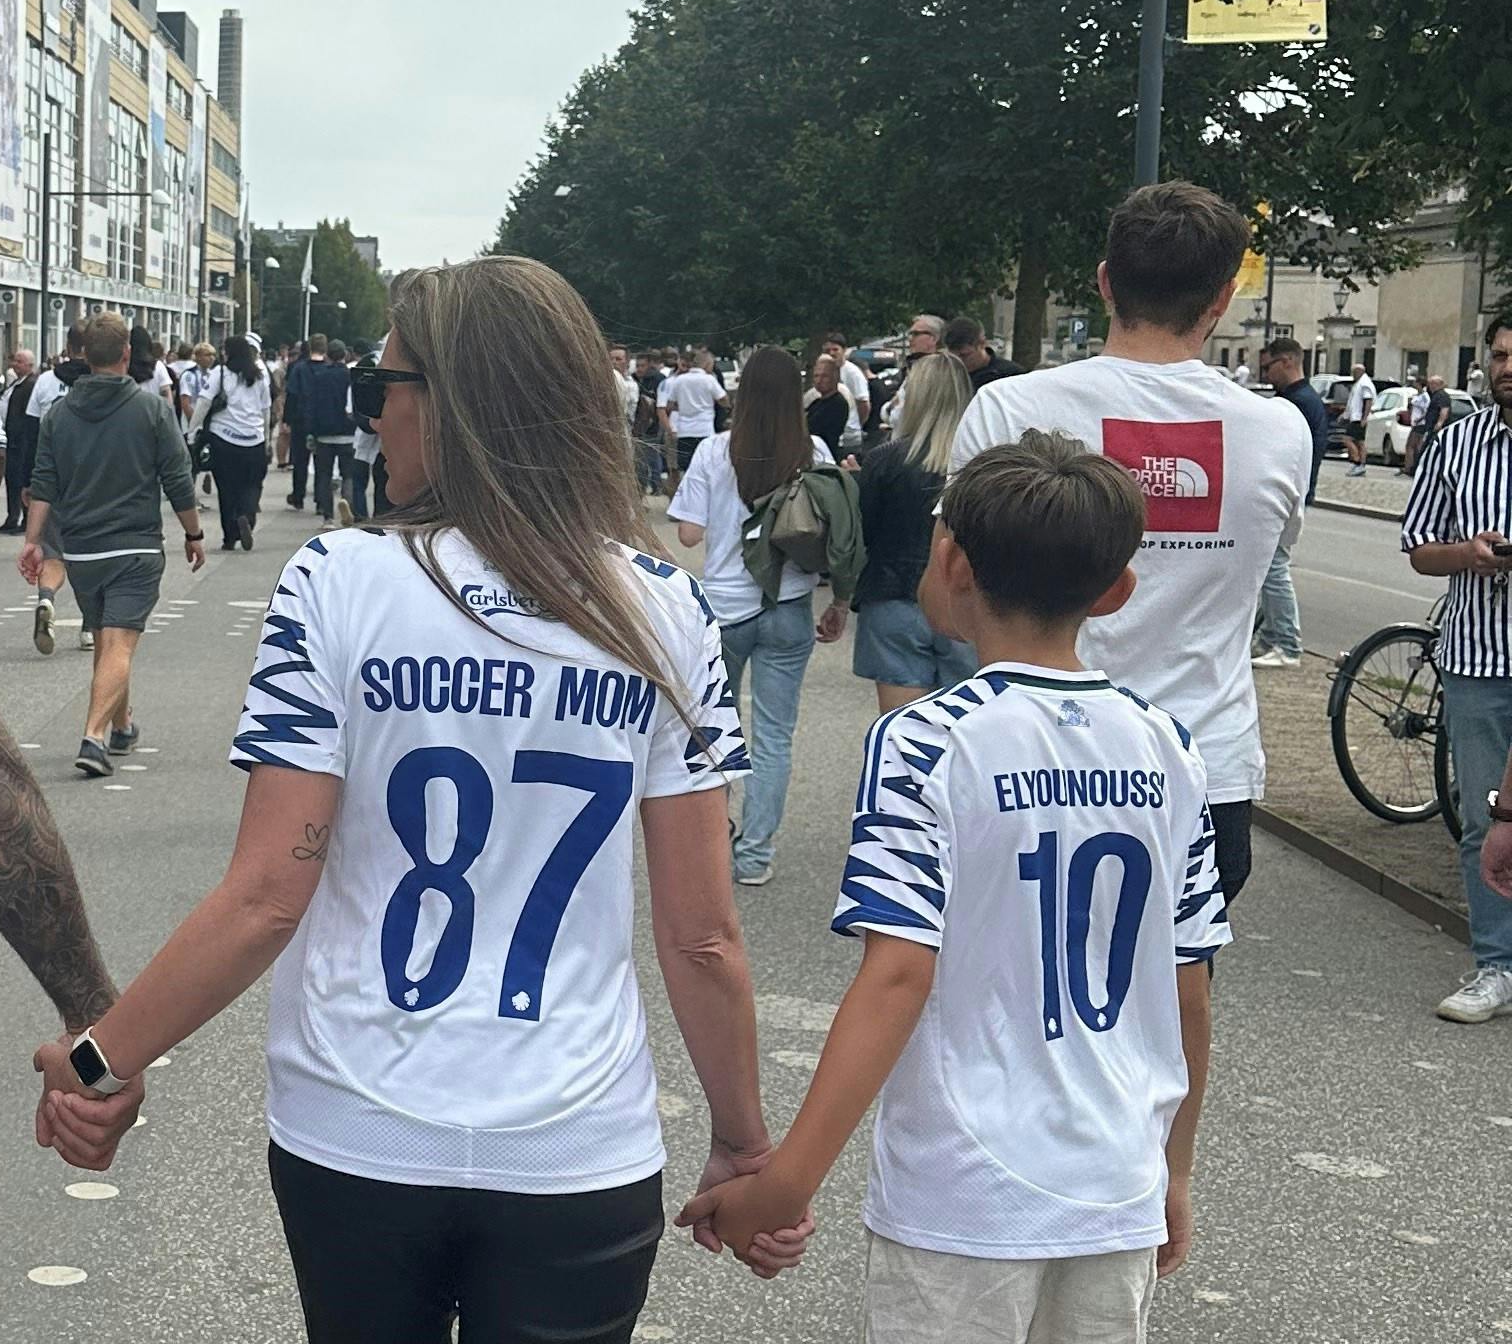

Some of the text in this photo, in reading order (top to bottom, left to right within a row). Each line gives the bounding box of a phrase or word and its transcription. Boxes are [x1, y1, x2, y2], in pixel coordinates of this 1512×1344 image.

[1074, 321, 1084, 333] P
[1141, 455, 1176, 471] THE
[1128, 468, 1176, 485] ORTH
[1142, 483, 1176, 498] ACE
[1141, 538, 1236, 551] OP EXPLORING
[360, 655, 657, 735] SOCCER MOM
[380, 745, 634, 1023] 87
[1017, 830, 1153, 1042] 10
